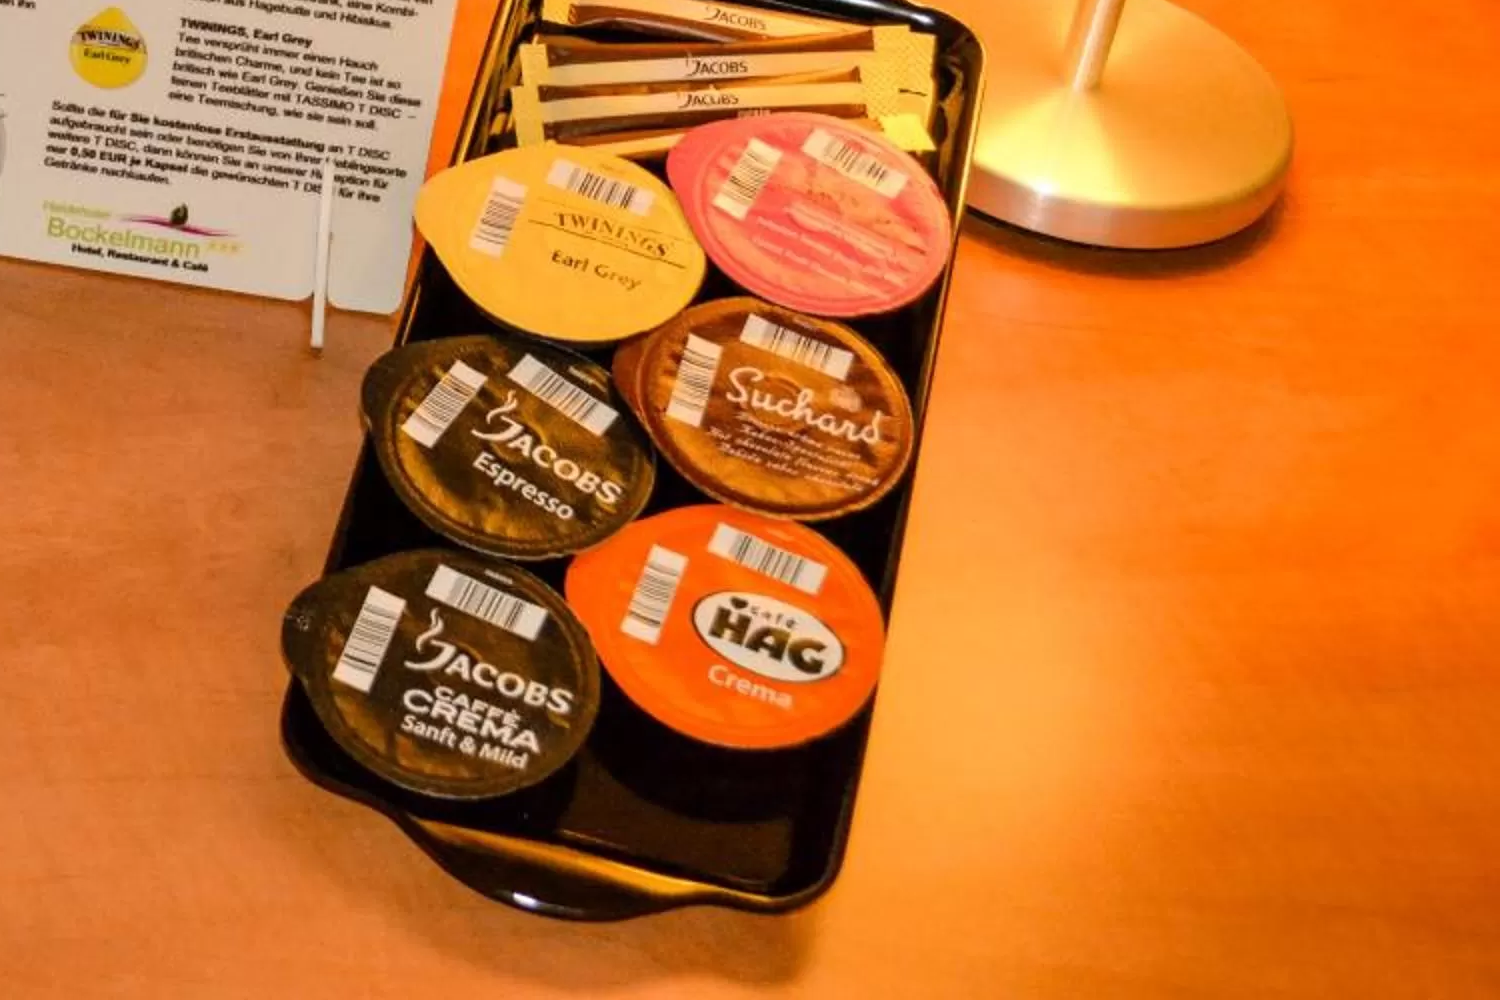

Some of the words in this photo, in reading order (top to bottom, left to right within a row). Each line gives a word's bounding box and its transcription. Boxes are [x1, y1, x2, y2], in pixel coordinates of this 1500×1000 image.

[179, 16, 250, 39] TWININGS,
[252, 27, 280, 42] Earl
[281, 32, 313, 49] Grey
[705, 5, 767, 31] JACOBS
[688, 57, 749, 77] JACOBS
[680, 89, 740, 110] JACOBS
[48, 216, 199, 258] Bockelmann
[554, 212, 669, 257] TWININGS
[552, 250, 588, 273] Earl
[594, 264, 642, 292] Grey
[726, 367, 884, 446] Suchard
[471, 415, 623, 505] JACOBS
[472, 450, 575, 521] Espresso
[708, 605, 828, 675] HAG
[404, 638, 574, 716] JACOBS
[707, 664, 794, 710] Crema
[401, 714, 458, 749] Sanft
[459, 734, 477, 756] &
[478, 742, 529, 771] Mild
[402, 688, 540, 754] CREMA
